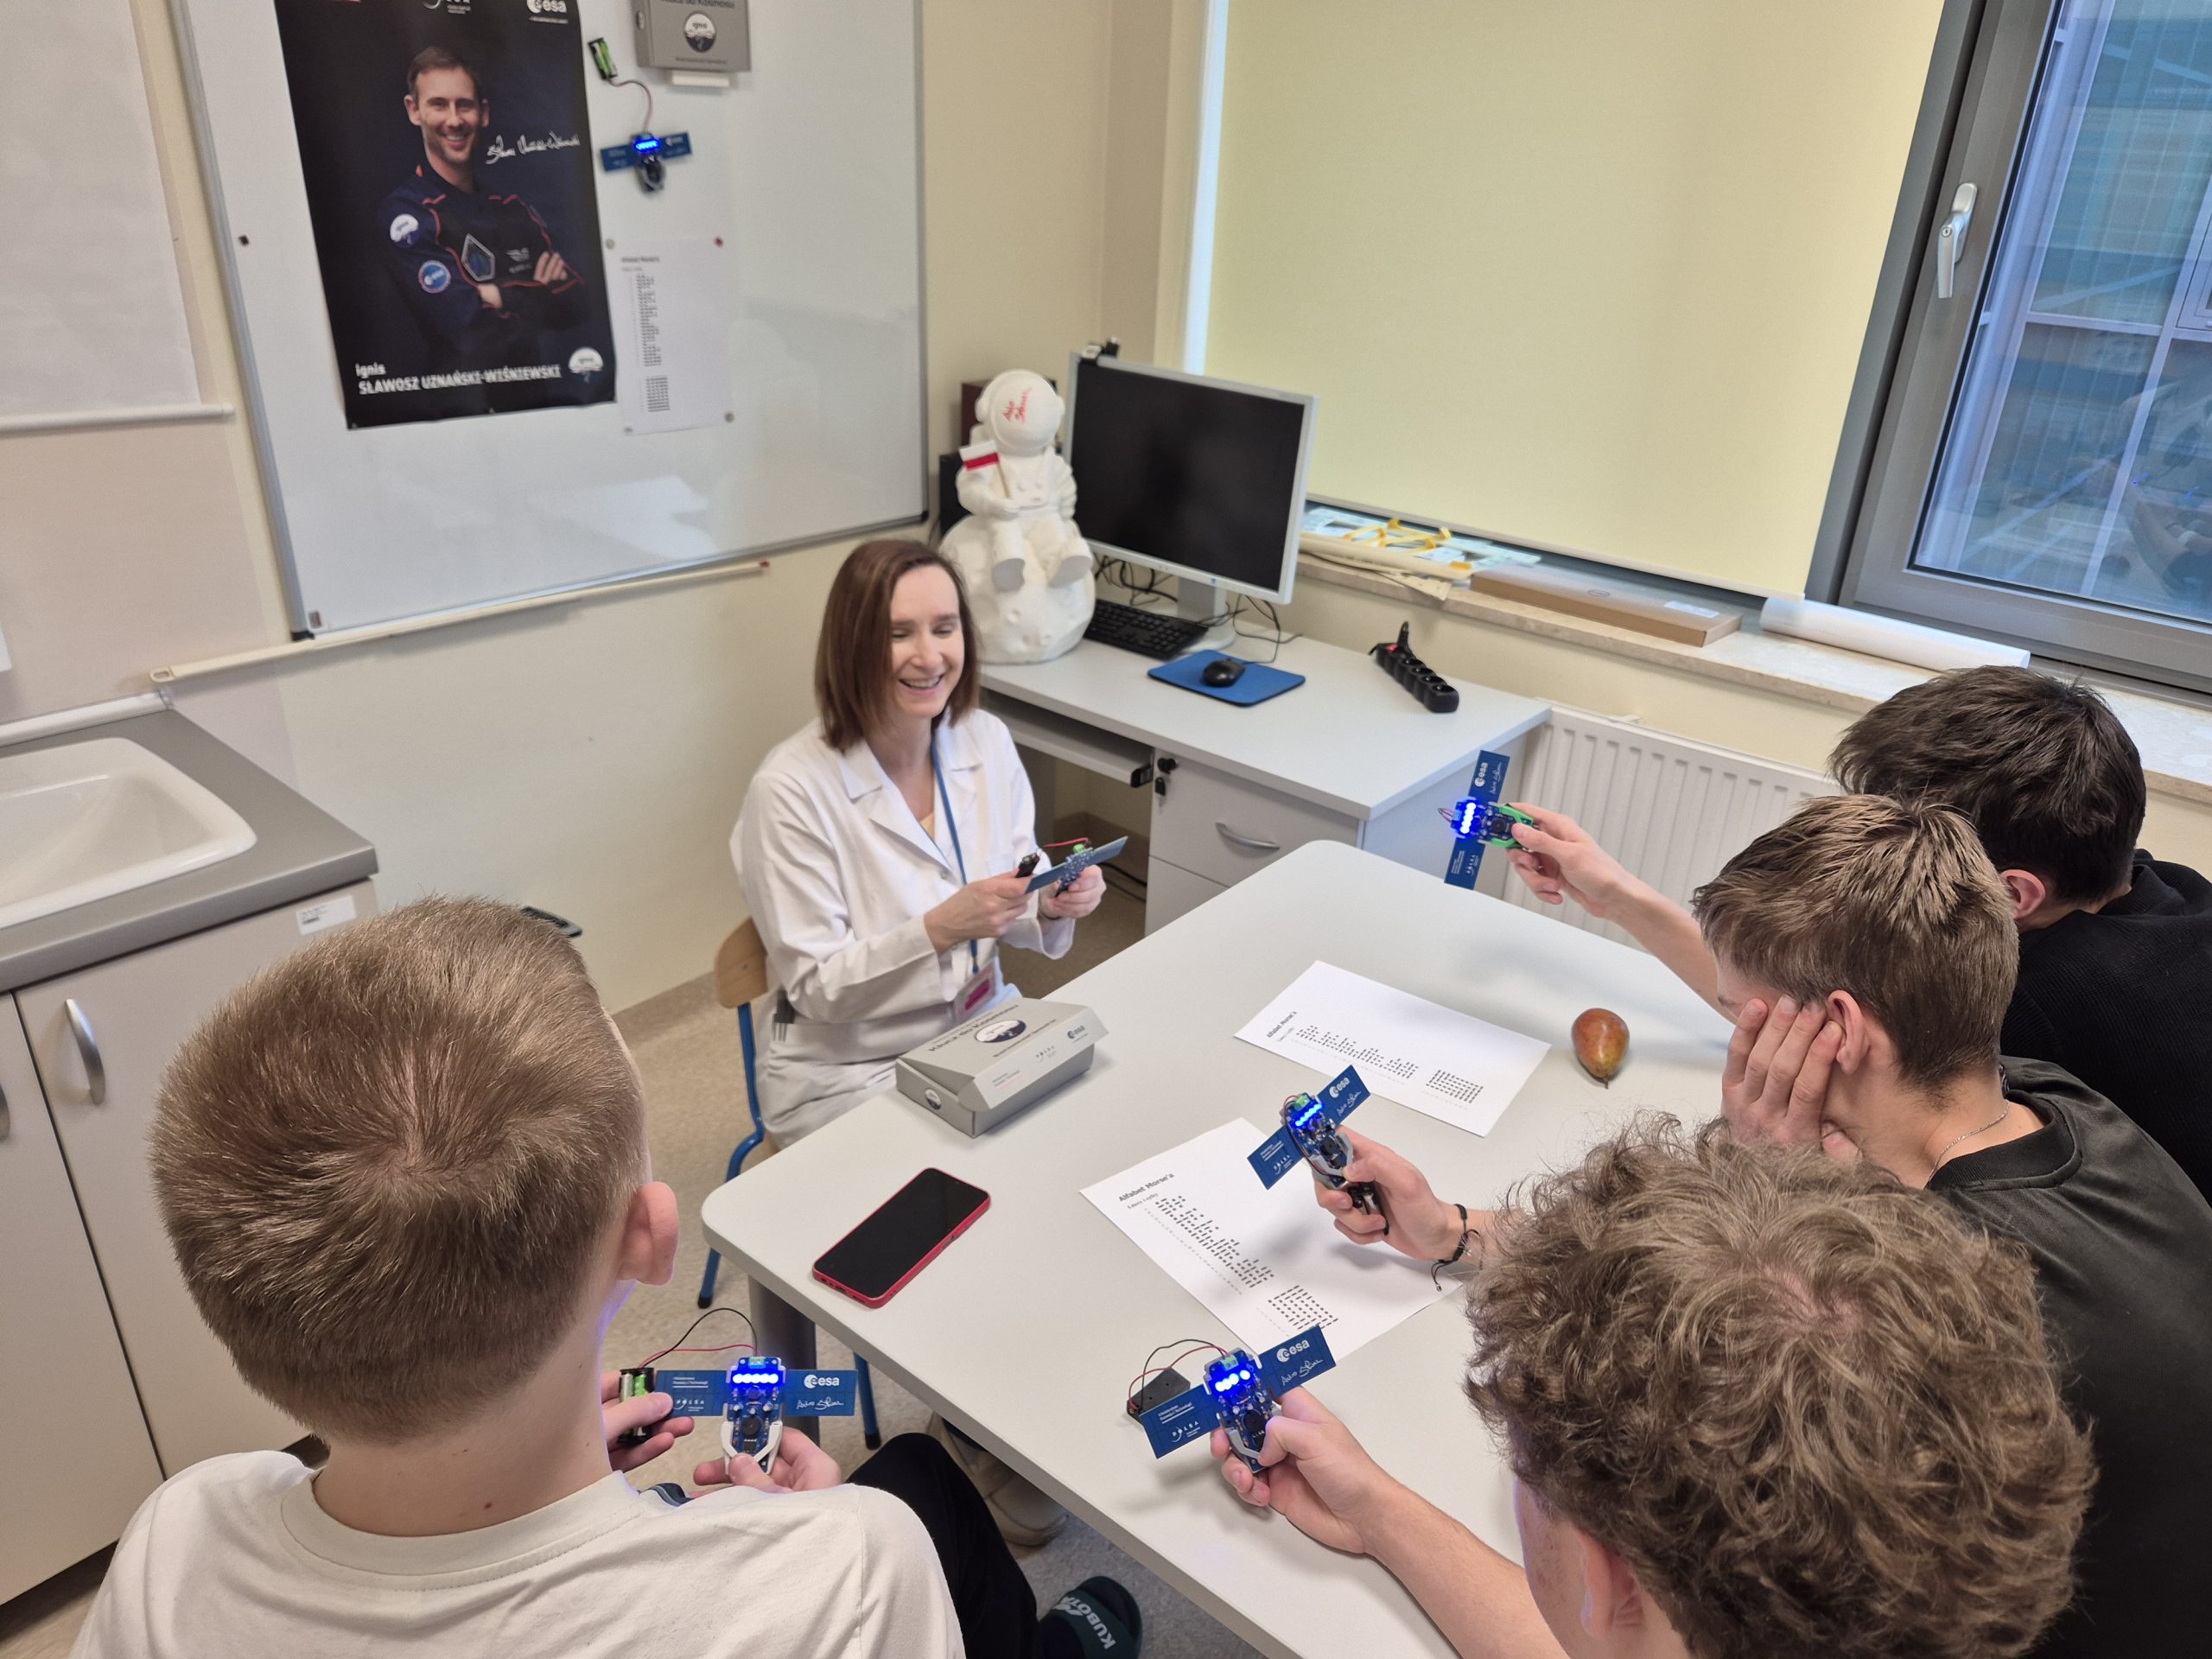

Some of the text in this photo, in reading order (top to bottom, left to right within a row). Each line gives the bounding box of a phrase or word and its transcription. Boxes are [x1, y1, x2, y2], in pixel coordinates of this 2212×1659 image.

[355, 362, 386, 378] ignis
[1118, 1186, 1146, 1202] Alfabet
[1062, 1596, 1116, 1649] KUBOTA
